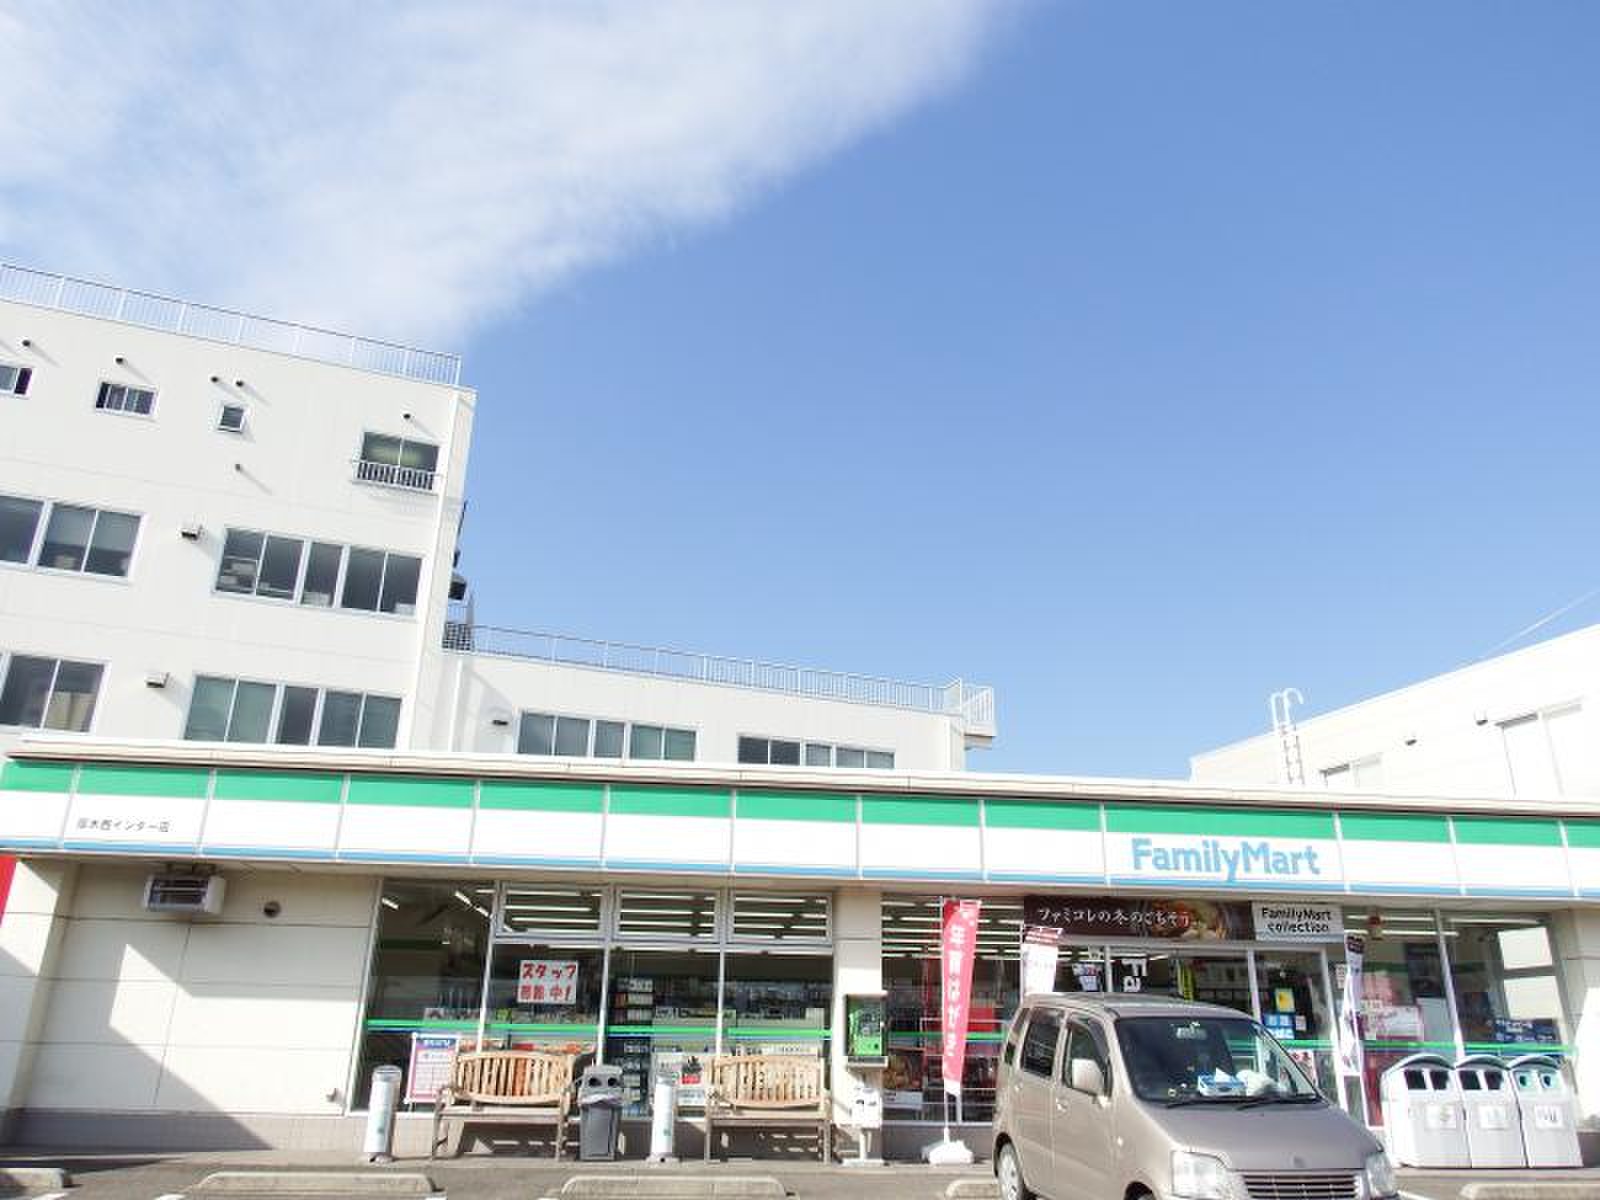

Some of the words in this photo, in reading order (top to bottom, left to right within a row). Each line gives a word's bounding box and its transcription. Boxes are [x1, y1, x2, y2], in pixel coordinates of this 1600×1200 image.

[1131, 837, 1321, 882] FamilyMart
[1262, 906, 1332, 921] FamilyMart
[1267, 921, 1329, 933] collection
[522, 962, 577, 979] スタッフ
